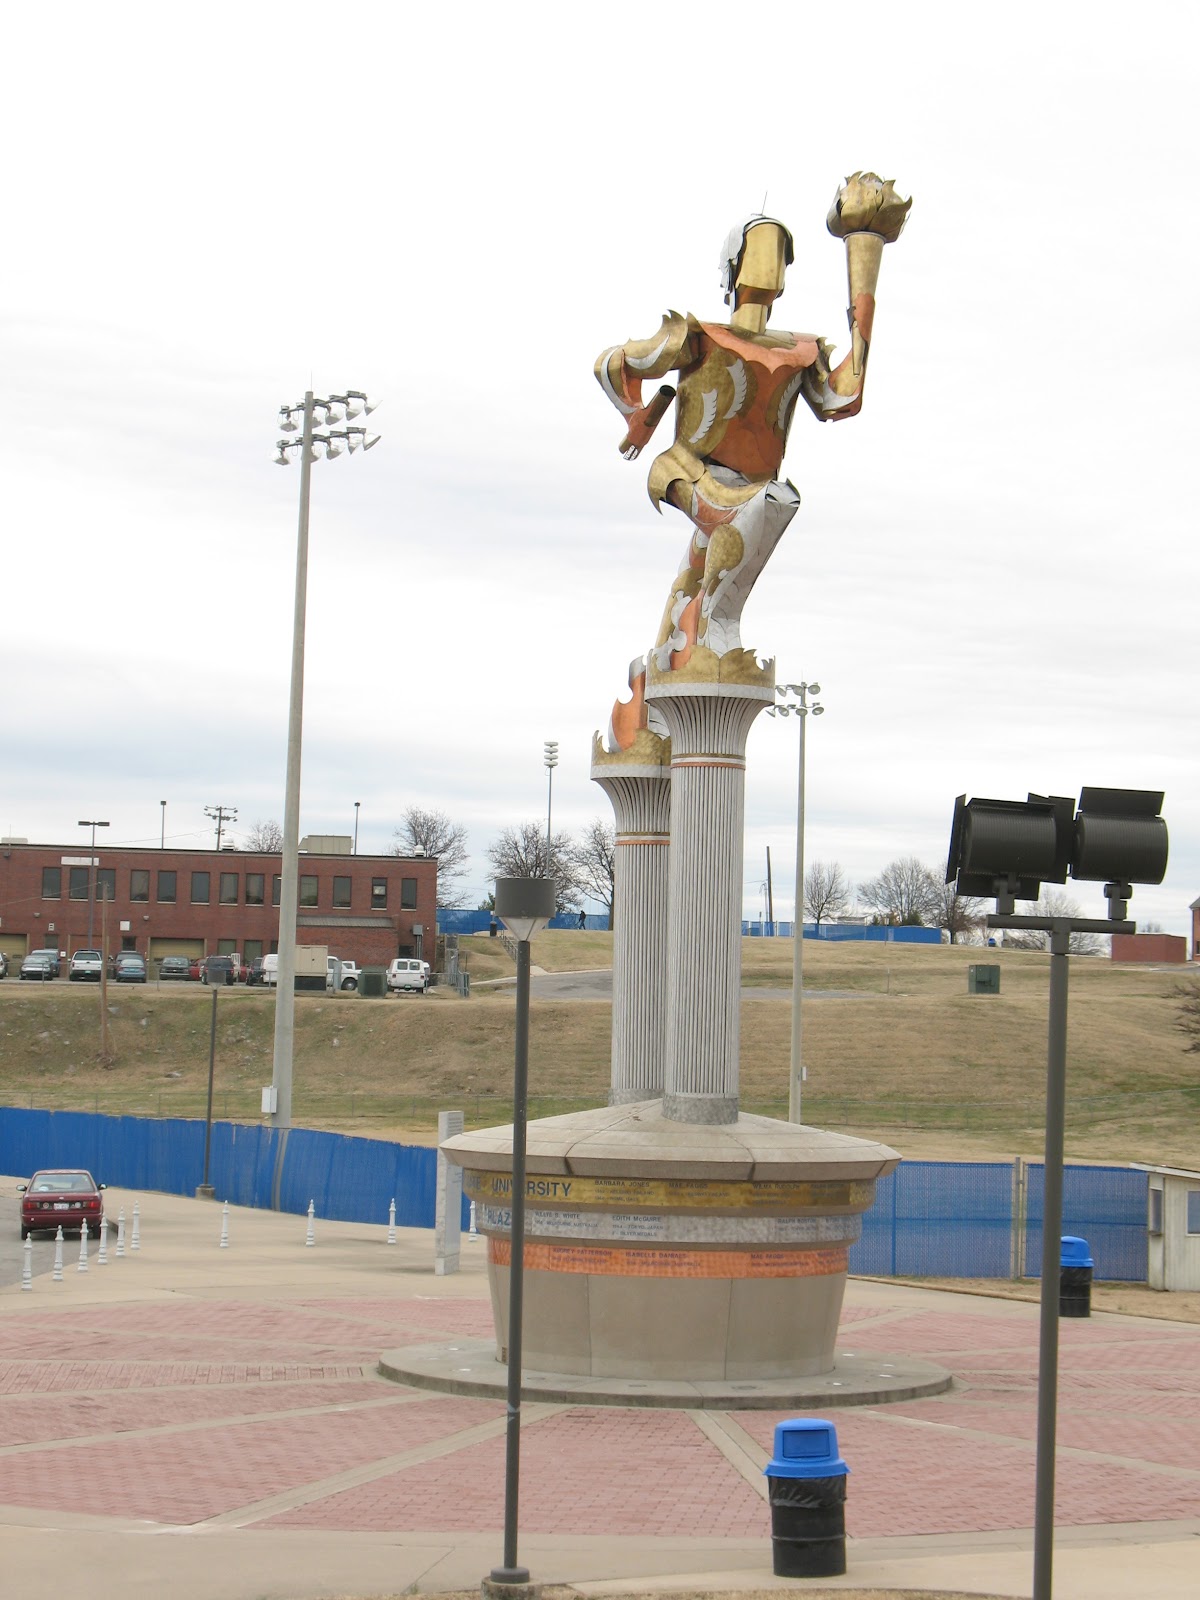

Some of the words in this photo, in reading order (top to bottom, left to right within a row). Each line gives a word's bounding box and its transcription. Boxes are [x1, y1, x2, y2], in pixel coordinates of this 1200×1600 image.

[491, 1177, 572, 1197] UNIRSITY
[487, 1210, 512, 1226] PLAZ
[577, 1249, 613, 1257] PATTERSON
